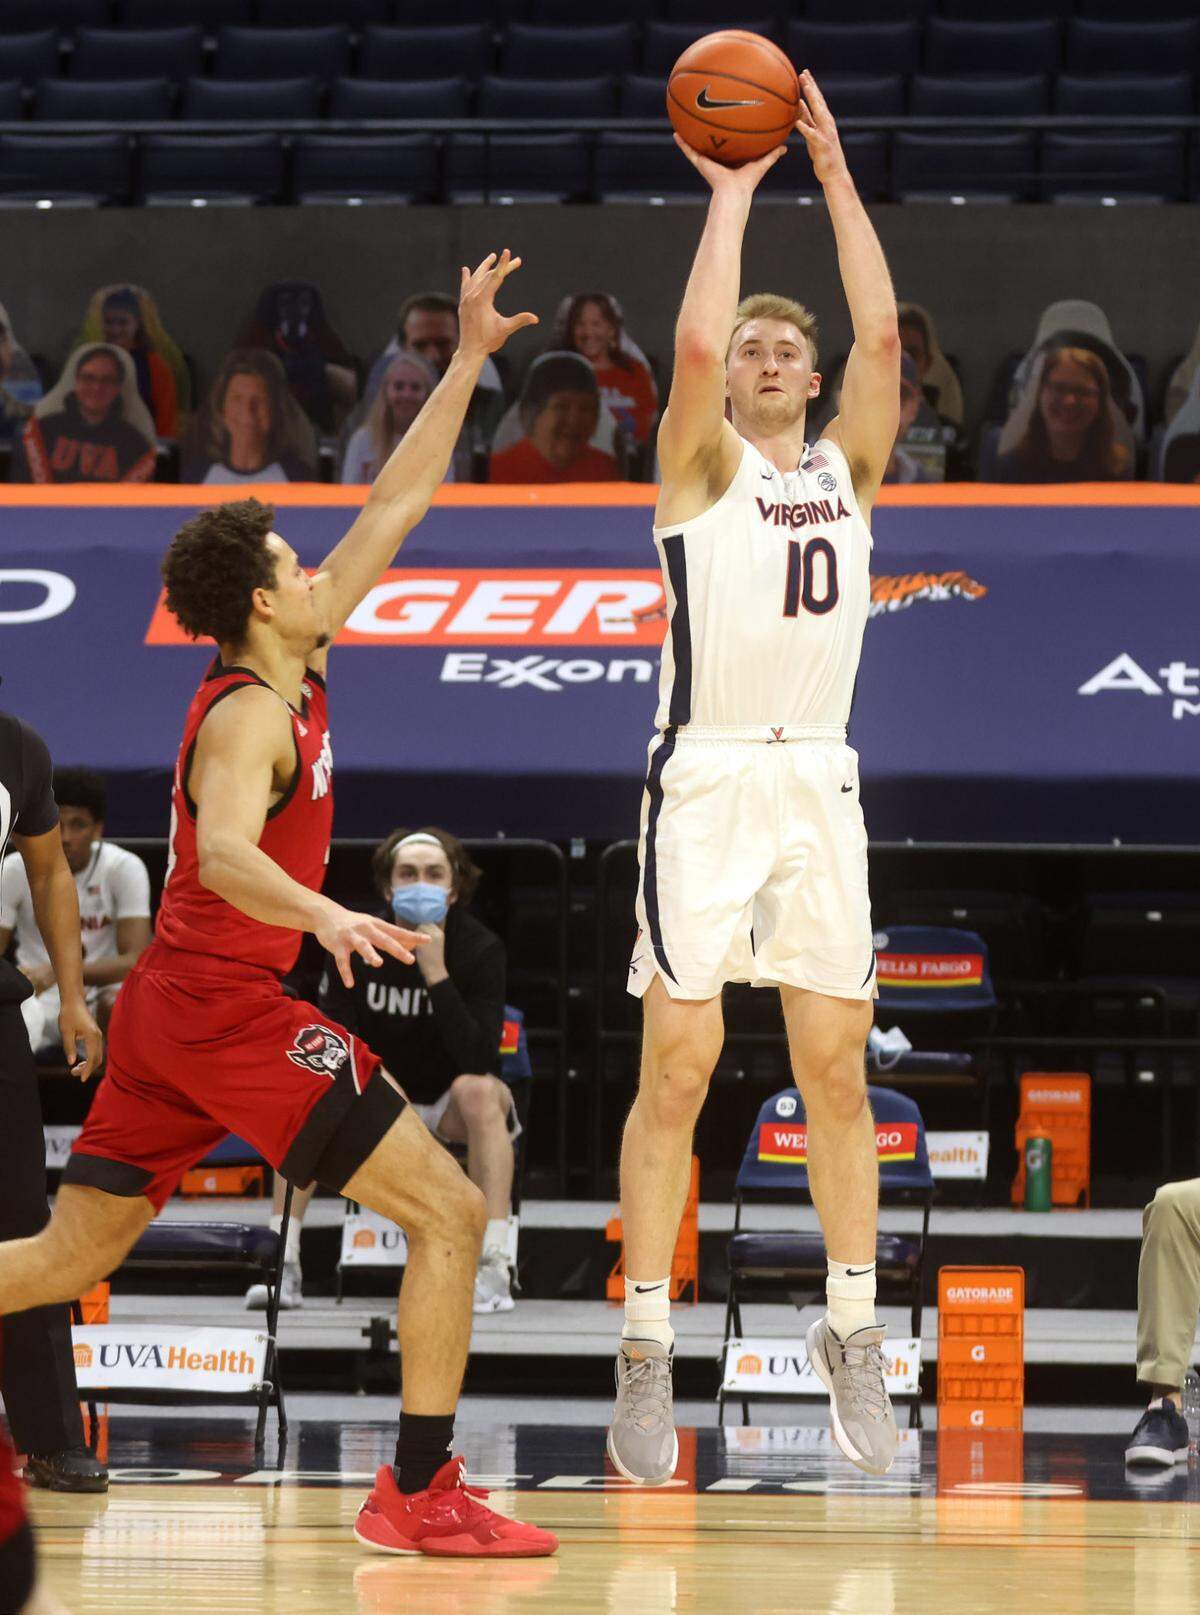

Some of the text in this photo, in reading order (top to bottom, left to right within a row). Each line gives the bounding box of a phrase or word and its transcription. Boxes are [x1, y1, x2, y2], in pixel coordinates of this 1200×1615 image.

[755, 496, 852, 532] VIRGINIA
[783, 536, 839, 618] 10
[343, 579, 664, 635] GER
[440, 653, 653, 692] Exxon
[929, 1146, 979, 1163] ealth
[947, 1287, 1014, 1299] GATORADE
[971, 1345, 986, 1361] G
[768, 1355, 815, 1377] UV
[970, 1410, 985, 1426] G
